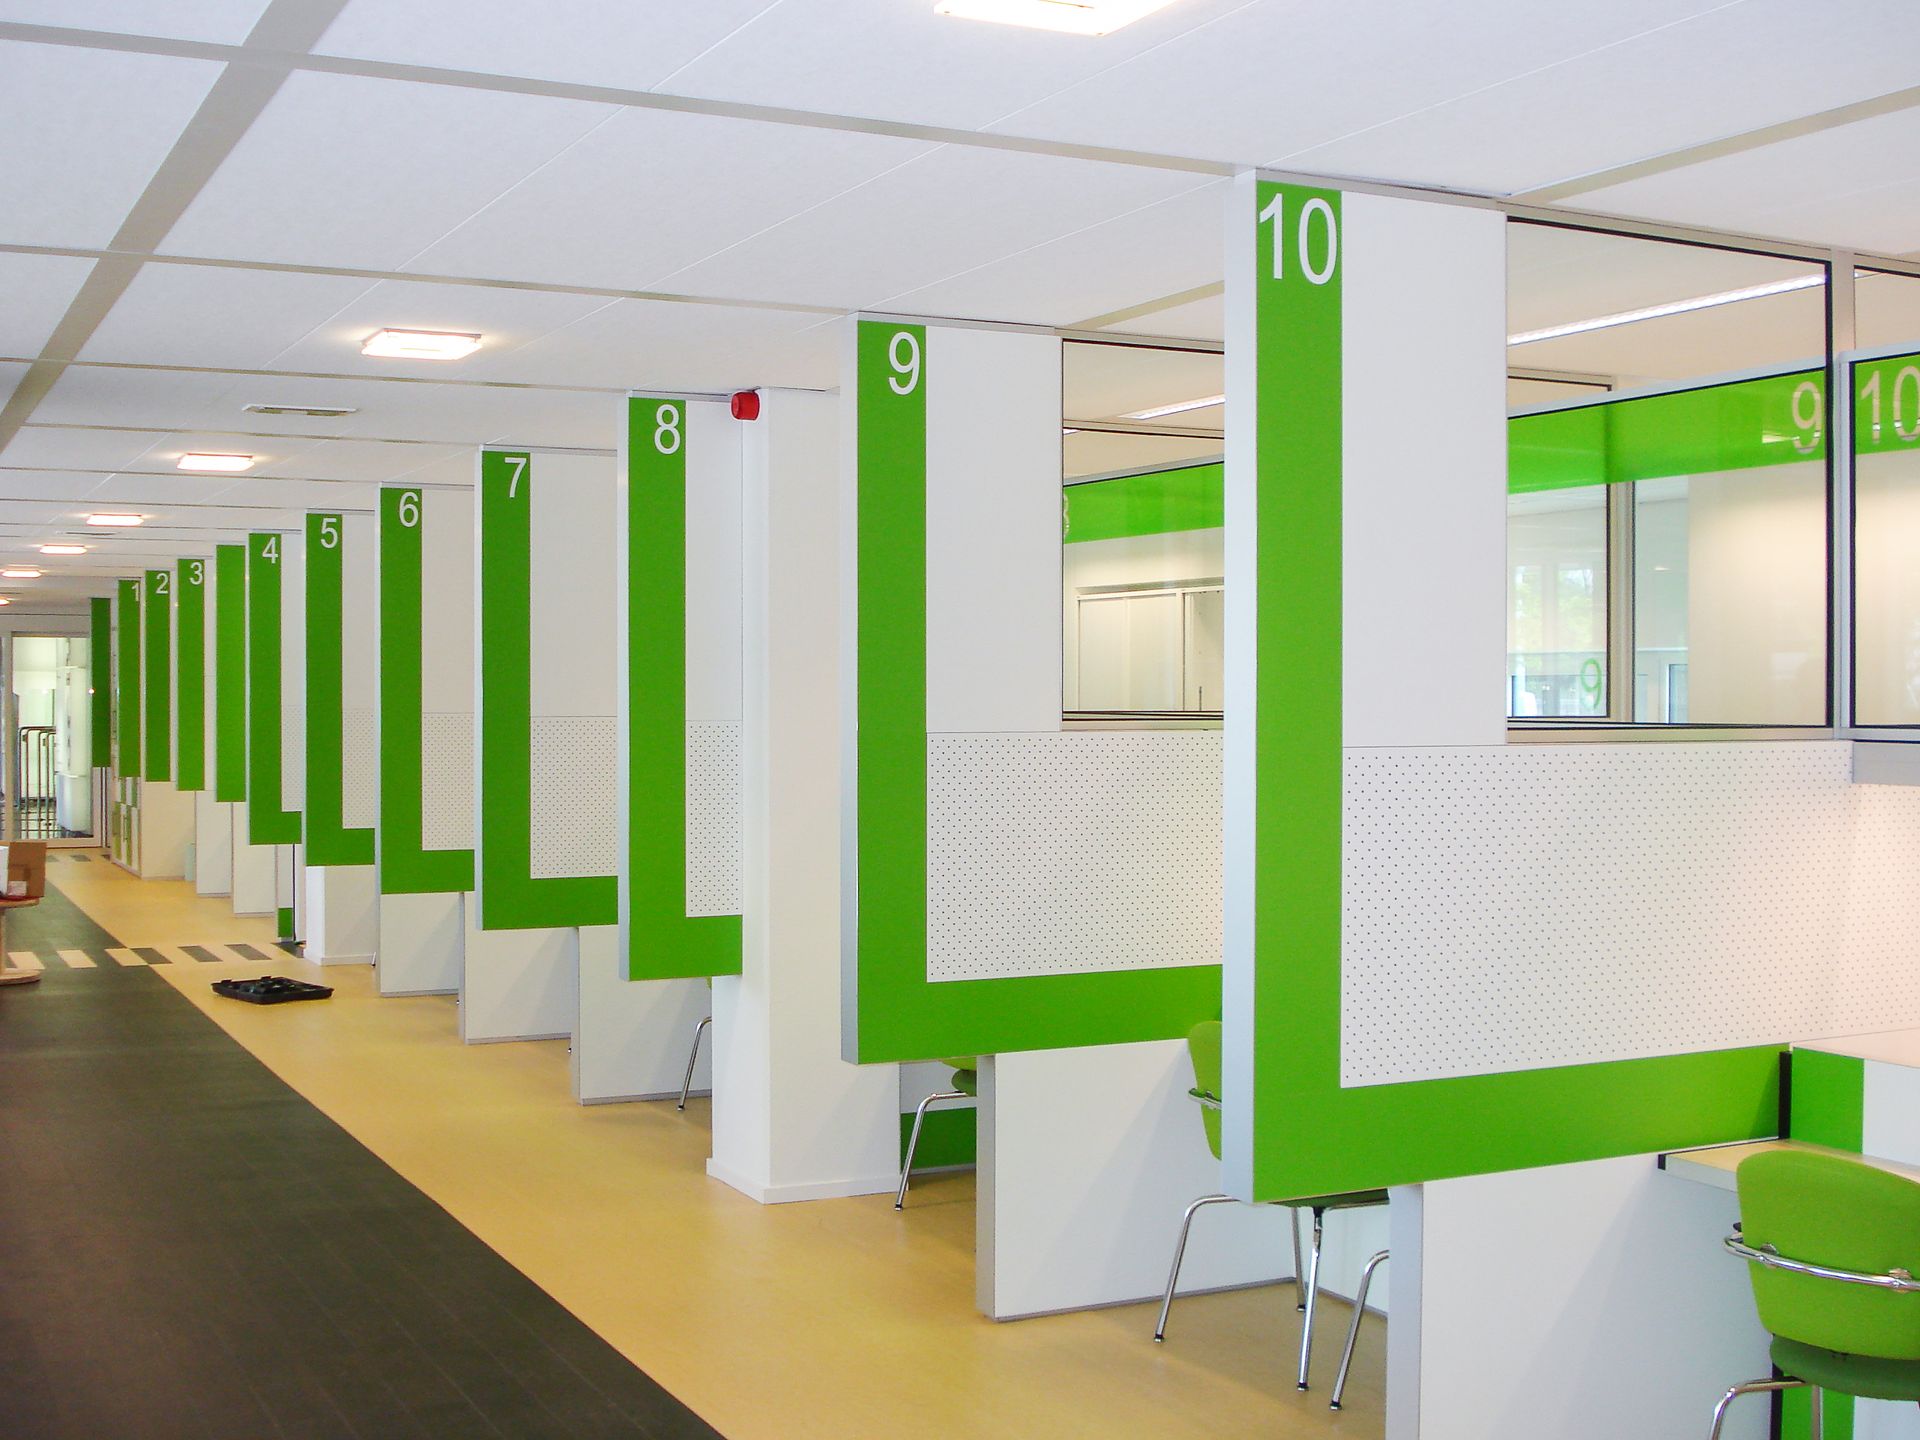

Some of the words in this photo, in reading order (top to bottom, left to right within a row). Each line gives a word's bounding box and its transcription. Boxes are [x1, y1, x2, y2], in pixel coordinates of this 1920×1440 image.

[1258, 192, 1338, 287] 10
[888, 332, 920, 395] 9
[1792, 381, 1822, 454] 9
[1859, 366, 1920, 445] 10
[654, 404, 681, 455] 8
[504, 456, 528, 499] 7
[398, 491, 421, 529] 6
[262, 536, 279, 564] 4
[320, 516, 339, 550] 5
[131, 582, 140, 602] 1
[155, 572, 169, 595] 2
[190, 561, 204, 585] 3
